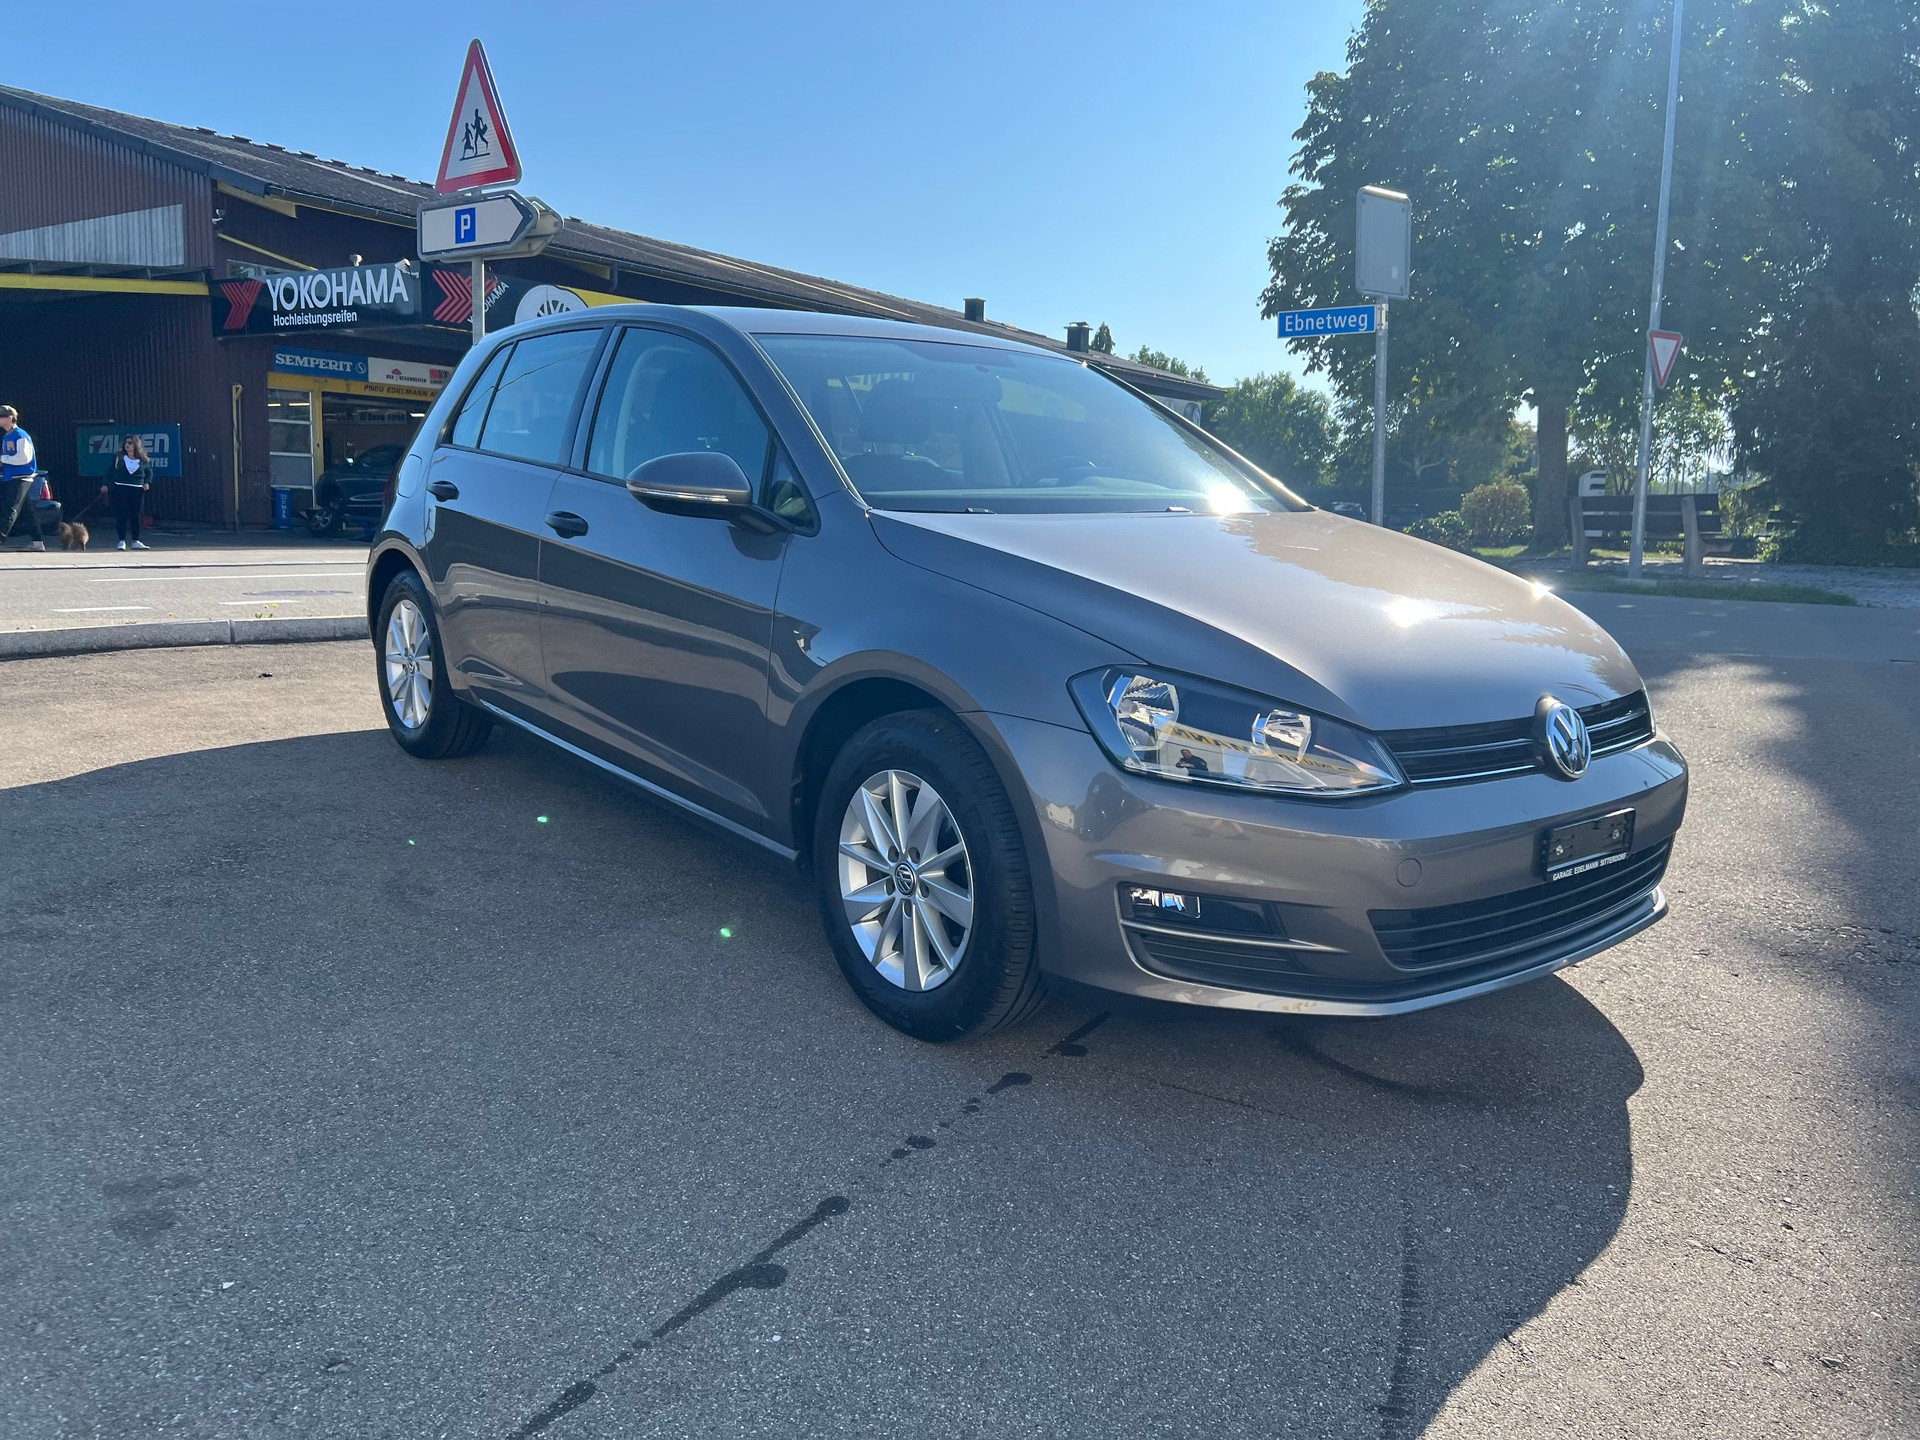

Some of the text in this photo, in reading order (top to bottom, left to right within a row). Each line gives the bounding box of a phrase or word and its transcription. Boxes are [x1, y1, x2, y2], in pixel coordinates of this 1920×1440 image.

[460, 214, 471, 239] P
[266, 268, 409, 312] YOKOHAMA
[273, 309, 358, 327] Hochleistungsreifen
[1284, 313, 1368, 332] Ebnetweg
[275, 353, 353, 372] SEMPERIT
[364, 384, 384, 393] PNEU
[88, 433, 170, 453] FALEN
[148, 457, 168, 468] YRES
[1552, 868, 1573, 881] GARAGE
[1574, 861, 1599, 875] EDELMANN
